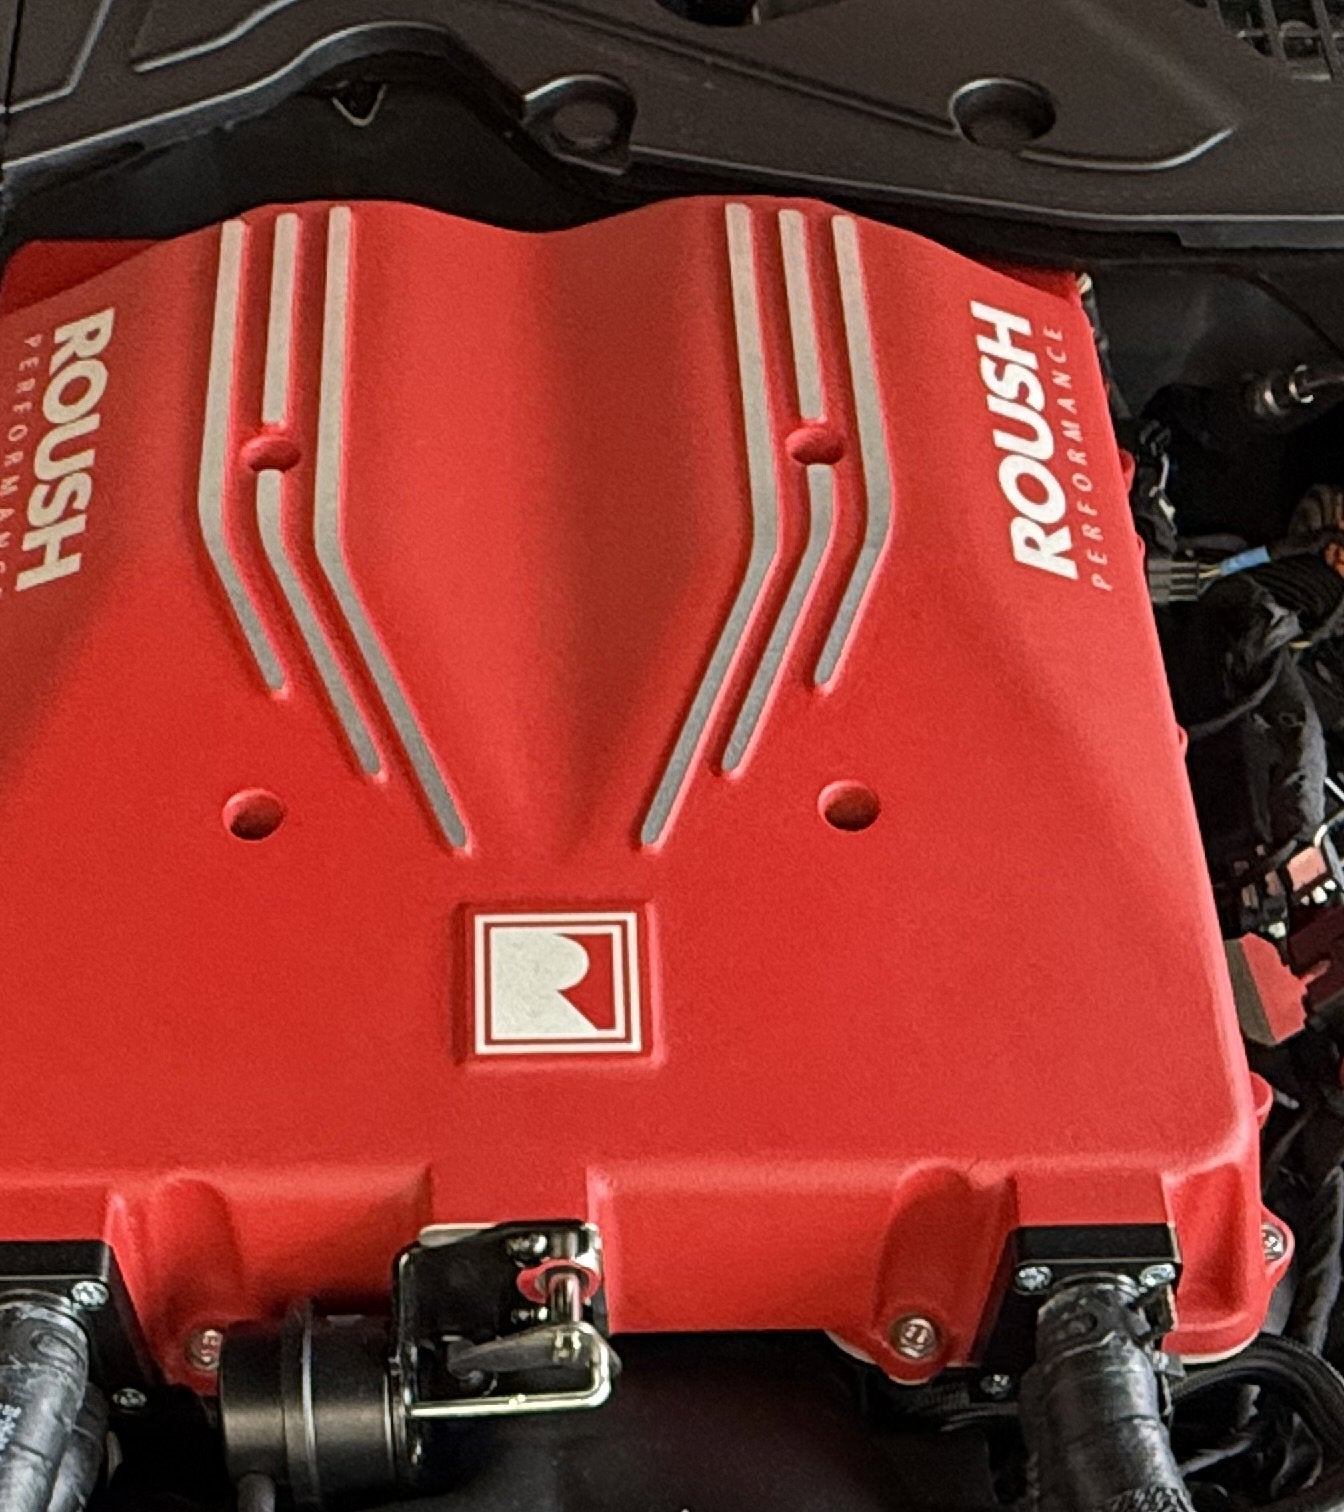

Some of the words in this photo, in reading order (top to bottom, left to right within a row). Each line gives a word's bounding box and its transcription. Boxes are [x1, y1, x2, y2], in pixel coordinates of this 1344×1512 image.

[15, 307, 115, 592] ROUSH
[969, 300, 1079, 581] ROUSH
[1043, 325, 1113, 592] PERFORMANCE
[490, 926, 616, 1041] R
